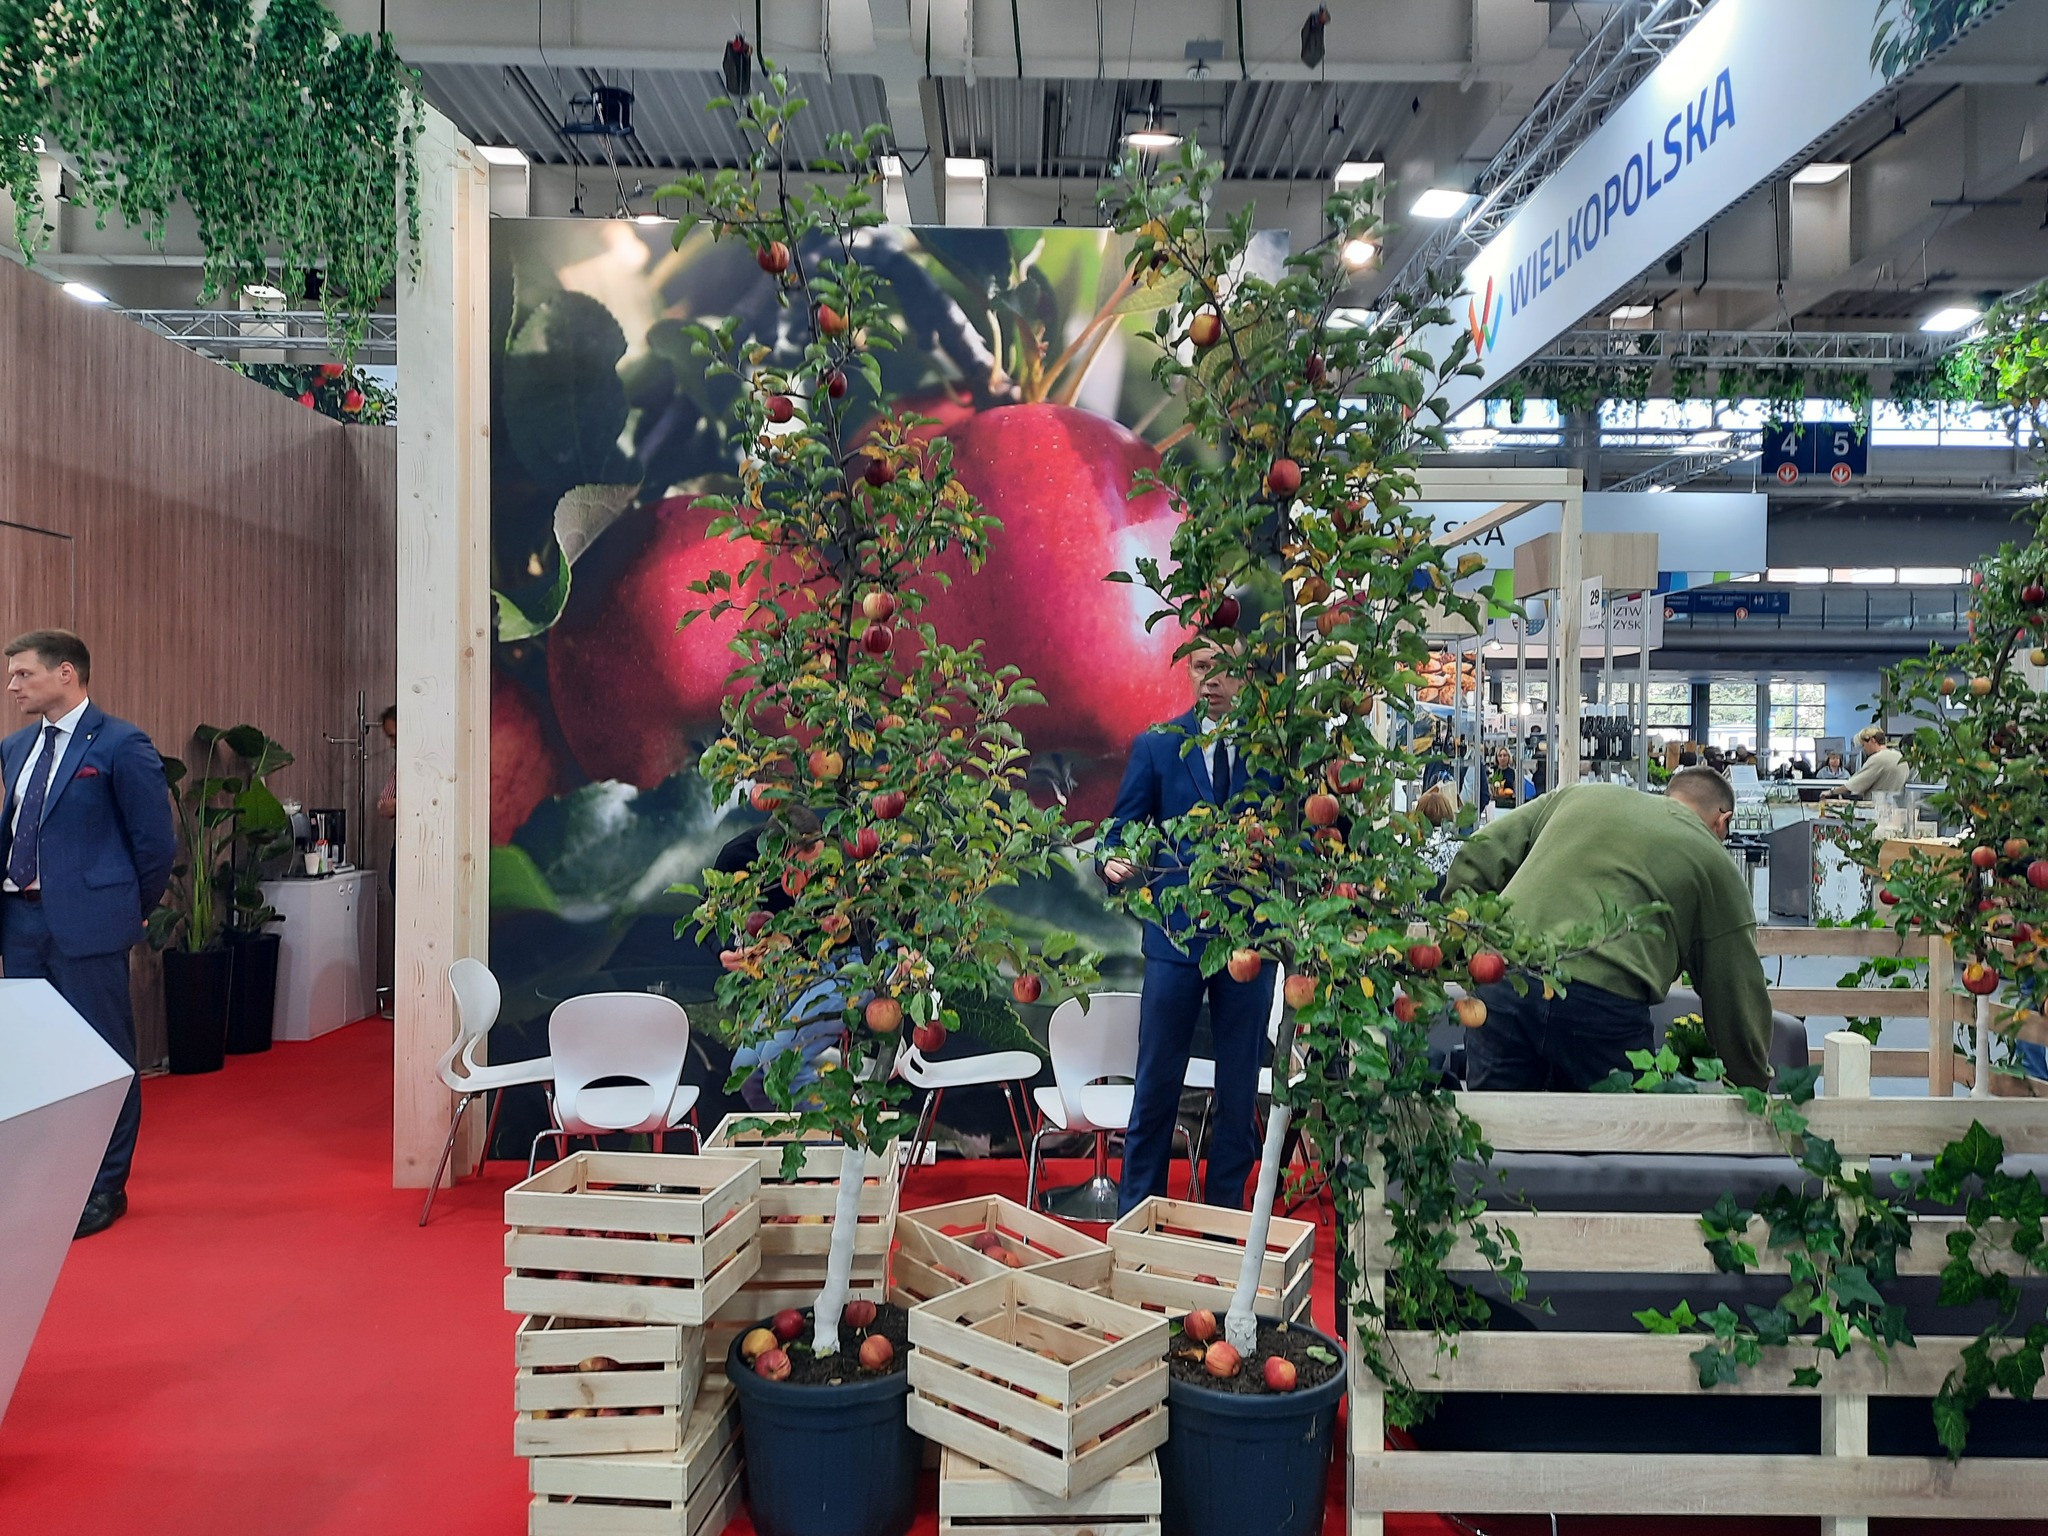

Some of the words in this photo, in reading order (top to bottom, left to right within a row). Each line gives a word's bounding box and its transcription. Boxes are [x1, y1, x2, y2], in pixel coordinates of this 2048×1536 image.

[1509, 65, 1736, 318] WIELKOPOLSKA
[1781, 431, 1798, 457] 4
[1833, 431, 1850, 456] 5
[1590, 588, 1600, 606] 29
